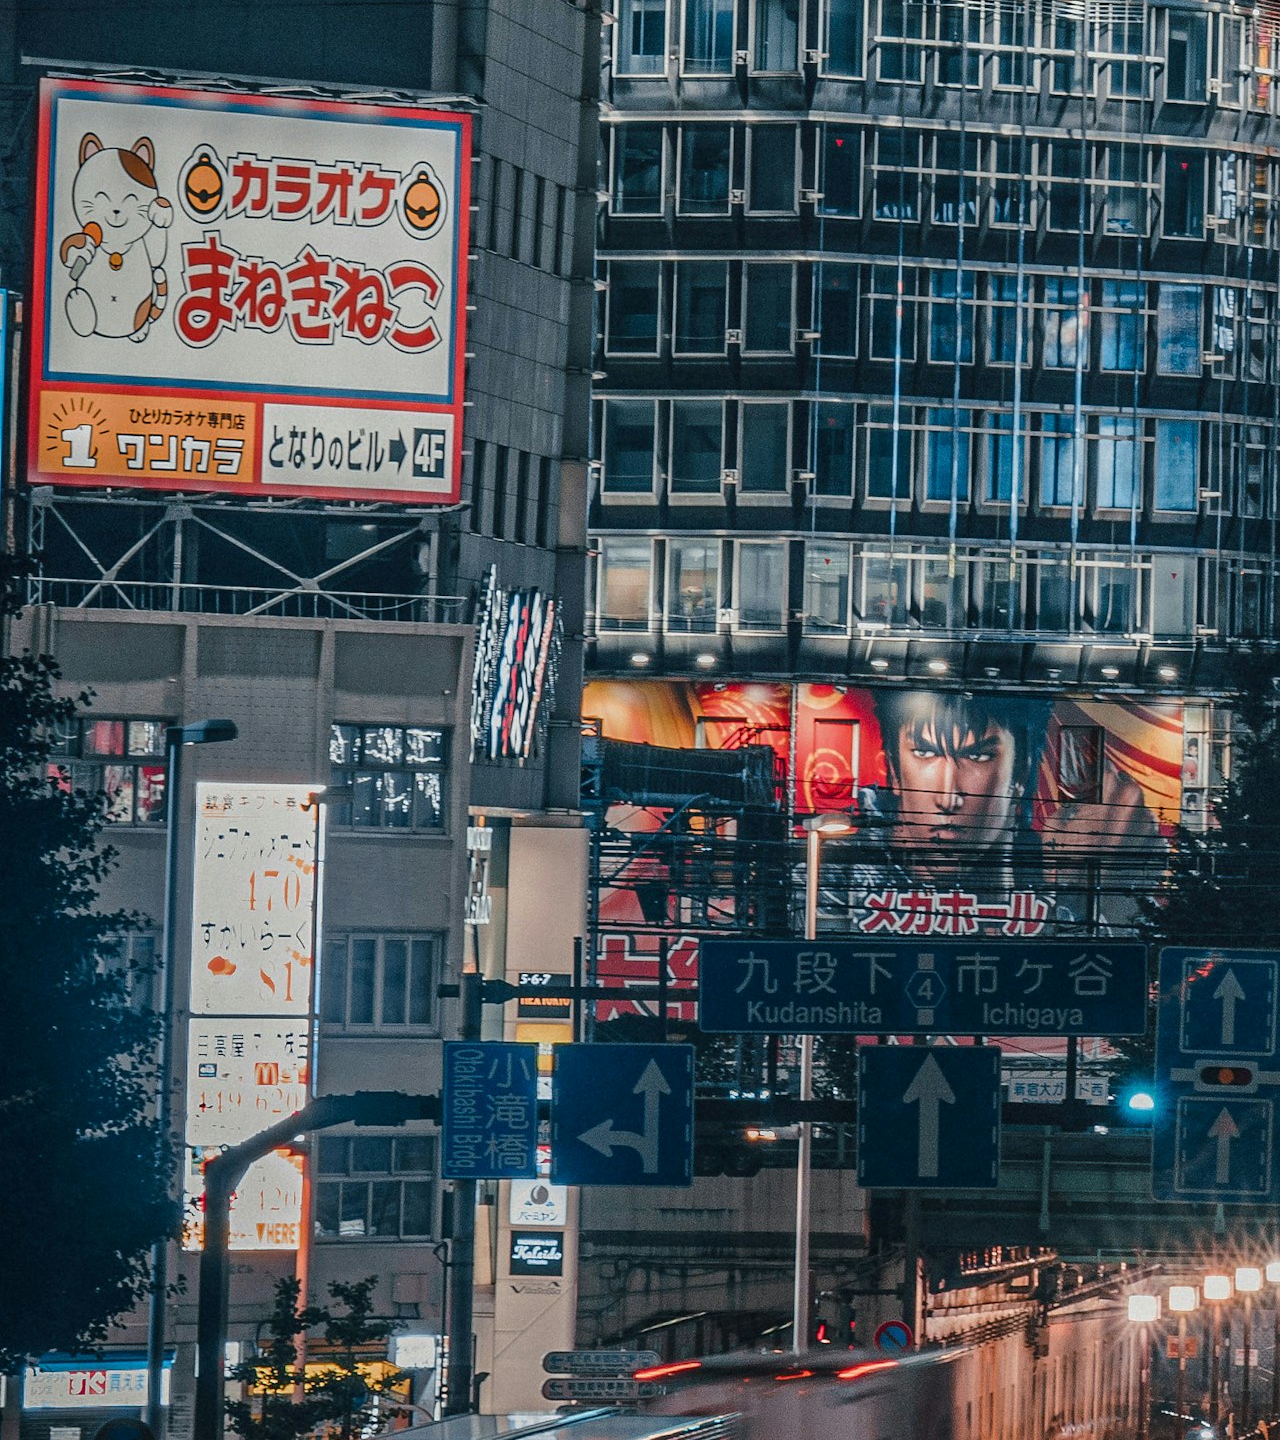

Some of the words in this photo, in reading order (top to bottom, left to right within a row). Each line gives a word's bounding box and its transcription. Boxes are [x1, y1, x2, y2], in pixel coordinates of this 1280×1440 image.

[229, 155, 399, 224] カラオケ
[178, 234, 442, 350] まねきねこ
[128, 407, 246, 429] ひとりカラオケ専門店
[116, 431, 246, 474] ワンカラ
[268, 425, 385, 470] となりのビル
[413, 431, 445, 475] 4F
[860, 889, 1050, 937] メガホール
[735, 950, 899, 996] 九段下
[917, 978, 933, 1000] 4
[747, 1000, 883, 1024] Kudanshita
[982, 1002, 1084, 1030] Ichigaya
[453, 1048, 484, 1132] Otakibashi
[1013, 1083, 1103, 1097] 新宿大ガド西
